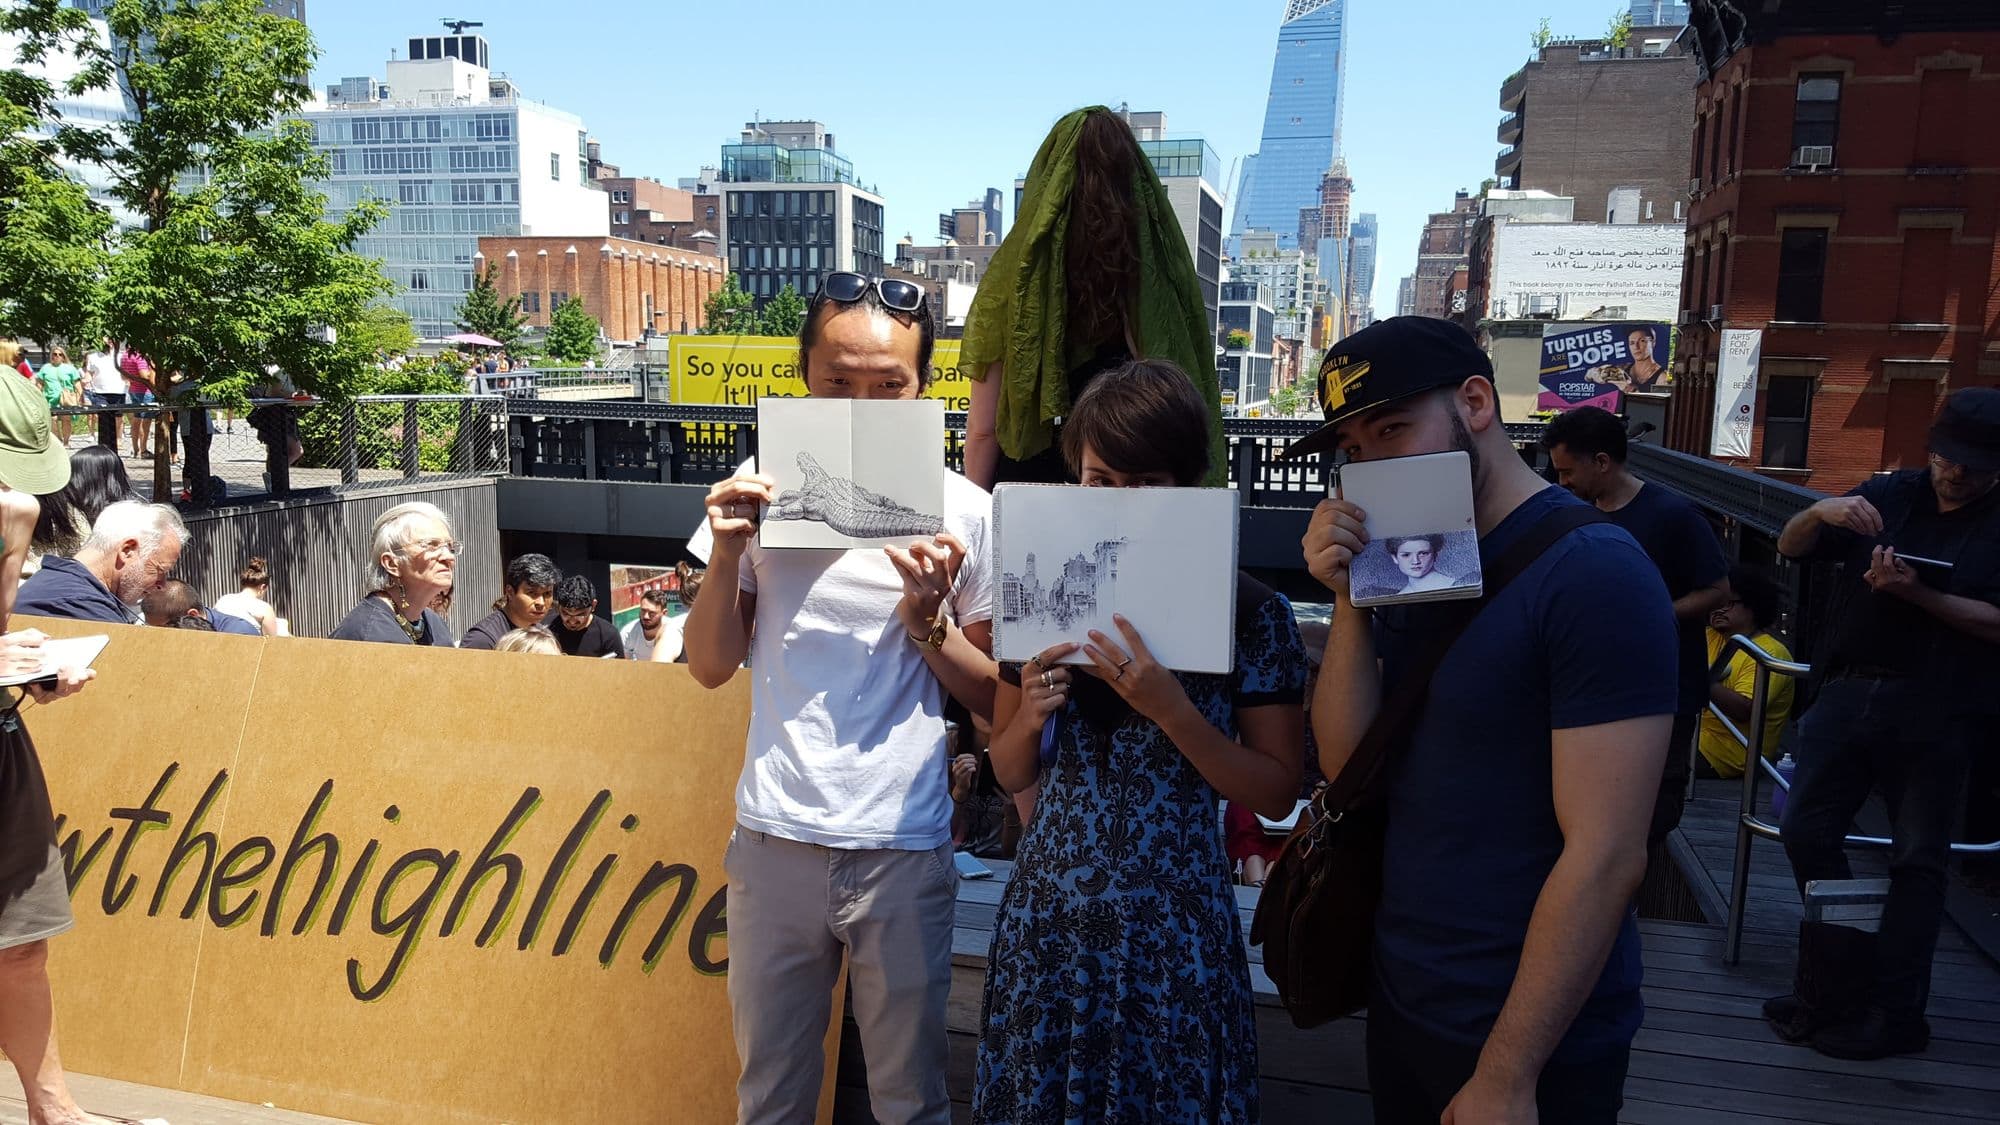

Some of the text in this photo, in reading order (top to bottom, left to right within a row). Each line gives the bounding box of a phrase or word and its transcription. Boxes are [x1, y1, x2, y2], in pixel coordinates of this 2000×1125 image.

[1553, 245, 1566, 256] الله
[1545, 329, 1613, 354] TURTLES
[1730, 340, 1747, 348] FOR
[1551, 341, 1626, 368] ARE DOPE
[1729, 347, 1750, 356] RENT
[687, 355, 715, 377] So
[722, 362, 763, 383] you
[1558, 382, 1595, 391] POPSTAR
[1734, 422, 1750, 430] 328
